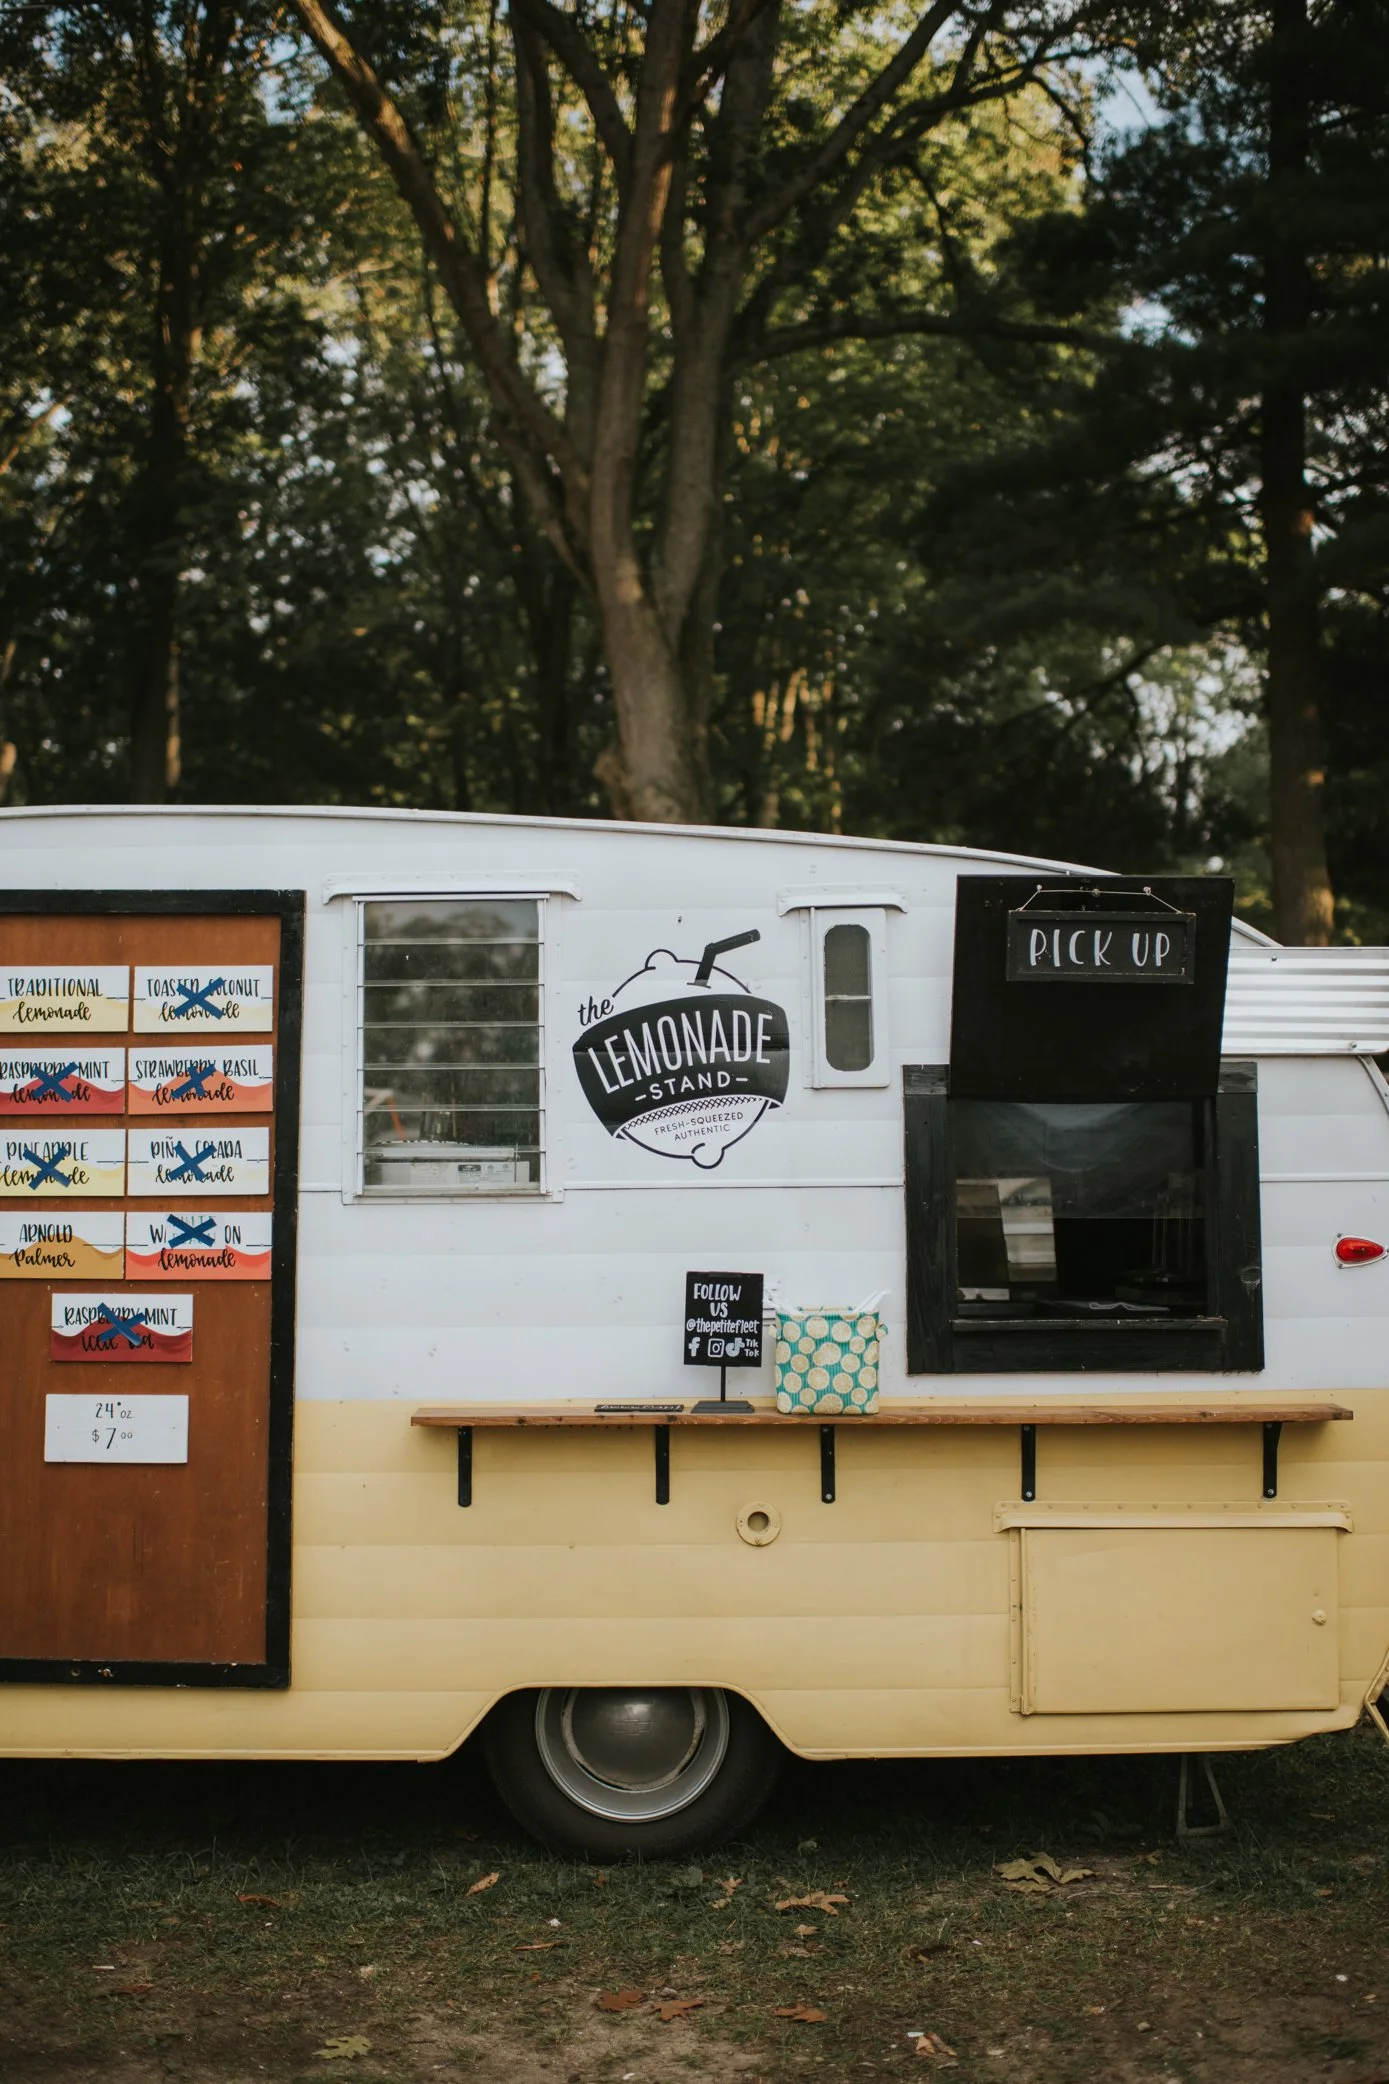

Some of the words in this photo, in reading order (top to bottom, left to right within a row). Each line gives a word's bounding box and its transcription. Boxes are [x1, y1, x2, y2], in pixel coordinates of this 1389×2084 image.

[1029, 928, 1113, 967] PICK
[1132, 932, 1170, 967] UP
[8, 977, 104, 997] TRADITIONAL
[12, 1000, 92, 1024] lemonade
[158, 1000, 240, 1022] leonde
[577, 995, 614, 1027] the
[587, 1009, 773, 1095] LEMONADE
[78, 1060, 110, 1079] MINT
[223, 1058, 260, 1077] BASIL
[9, 1082, 91, 1104] lemonde
[654, 1111, 744, 1136] FRESH-SQUEEZED
[674, 1123, 731, 1141] AUTHENTIC
[0, 1164, 90, 1187] lemnde
[155, 1164, 235, 1184] leoade
[19, 1223, 73, 1244] ARNOLD
[9, 1247, 76, 1268] Palmer
[158, 1247, 237, 1271] lemonade
[693, 1283, 742, 1301] FOLLOW
[144, 1307, 178, 1326] MINT
[709, 1302, 728, 1318] US
[686, 1317, 761, 1336] @thepetitefleet
